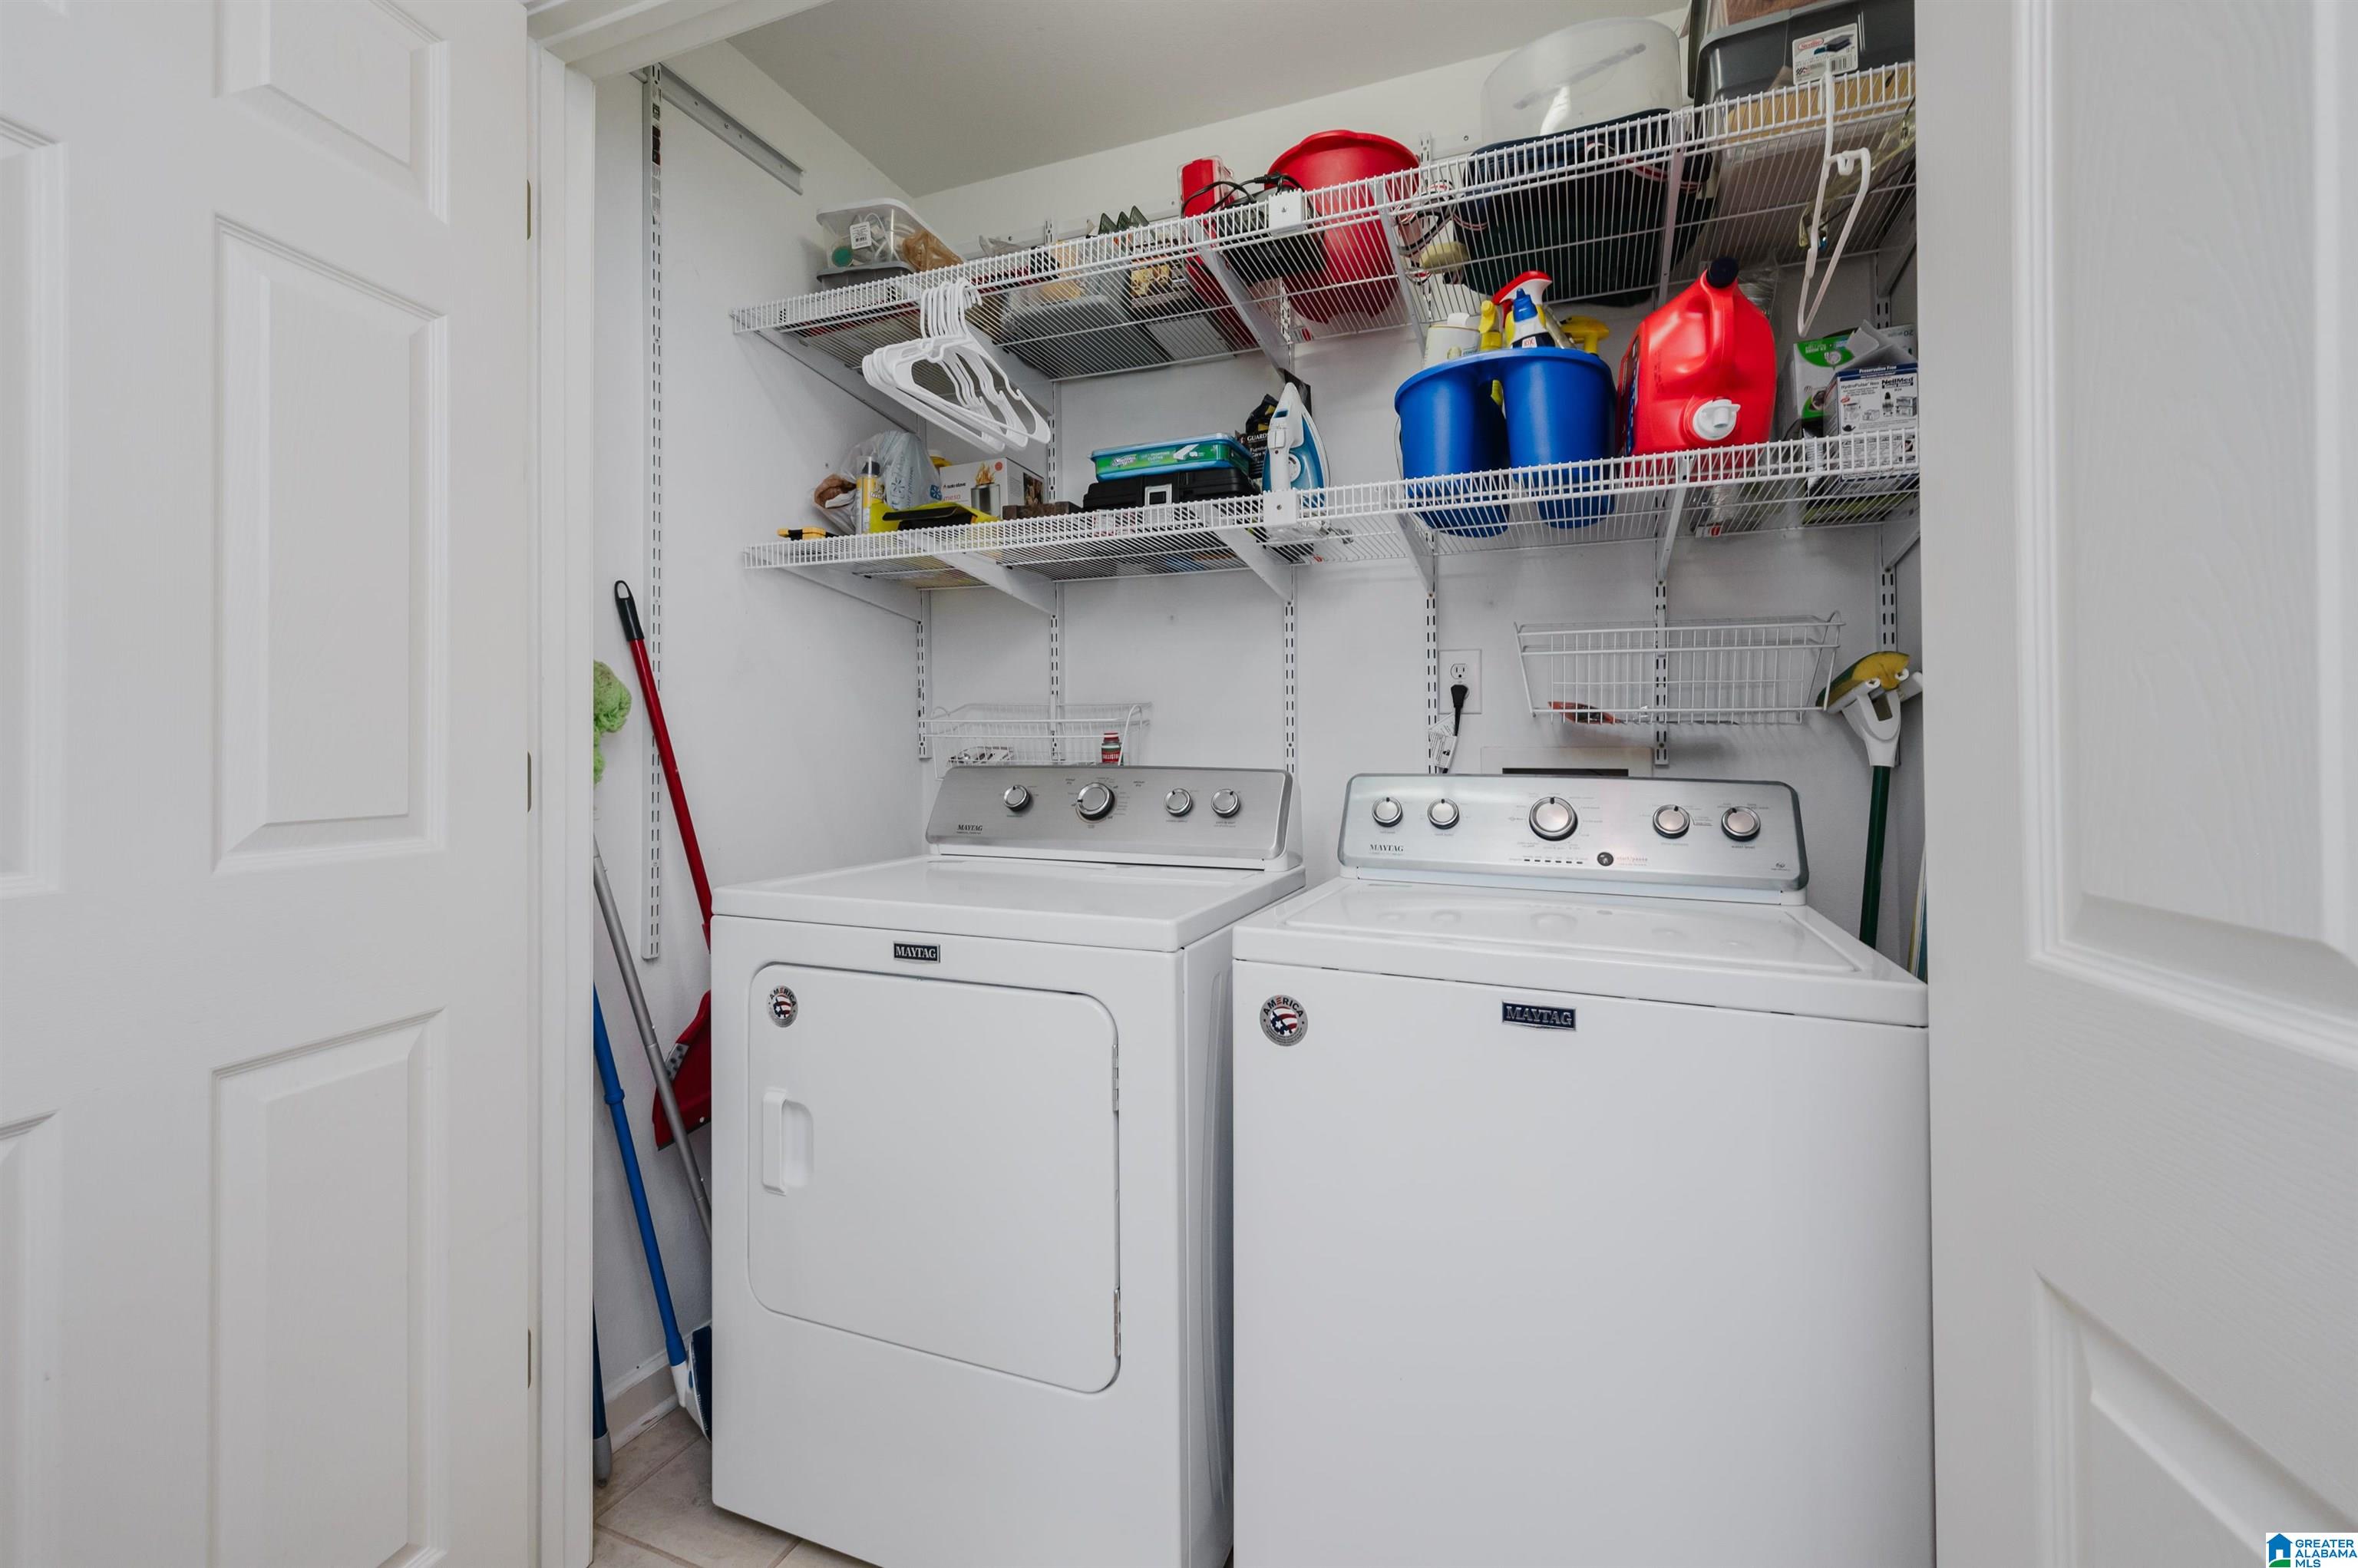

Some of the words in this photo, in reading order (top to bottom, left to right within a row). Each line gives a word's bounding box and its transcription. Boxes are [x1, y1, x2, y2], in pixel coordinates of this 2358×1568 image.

[1881, 377, 1914, 385] NeilMed
[1370, 843, 1404, 852] MAYTAG
[895, 945, 937, 959] MAYTAG
[769, 987, 796, 1006] AMERICA
[1263, 996, 1304, 1018] AMERICA
[1505, 1005, 1573, 1025] MAYTAG
